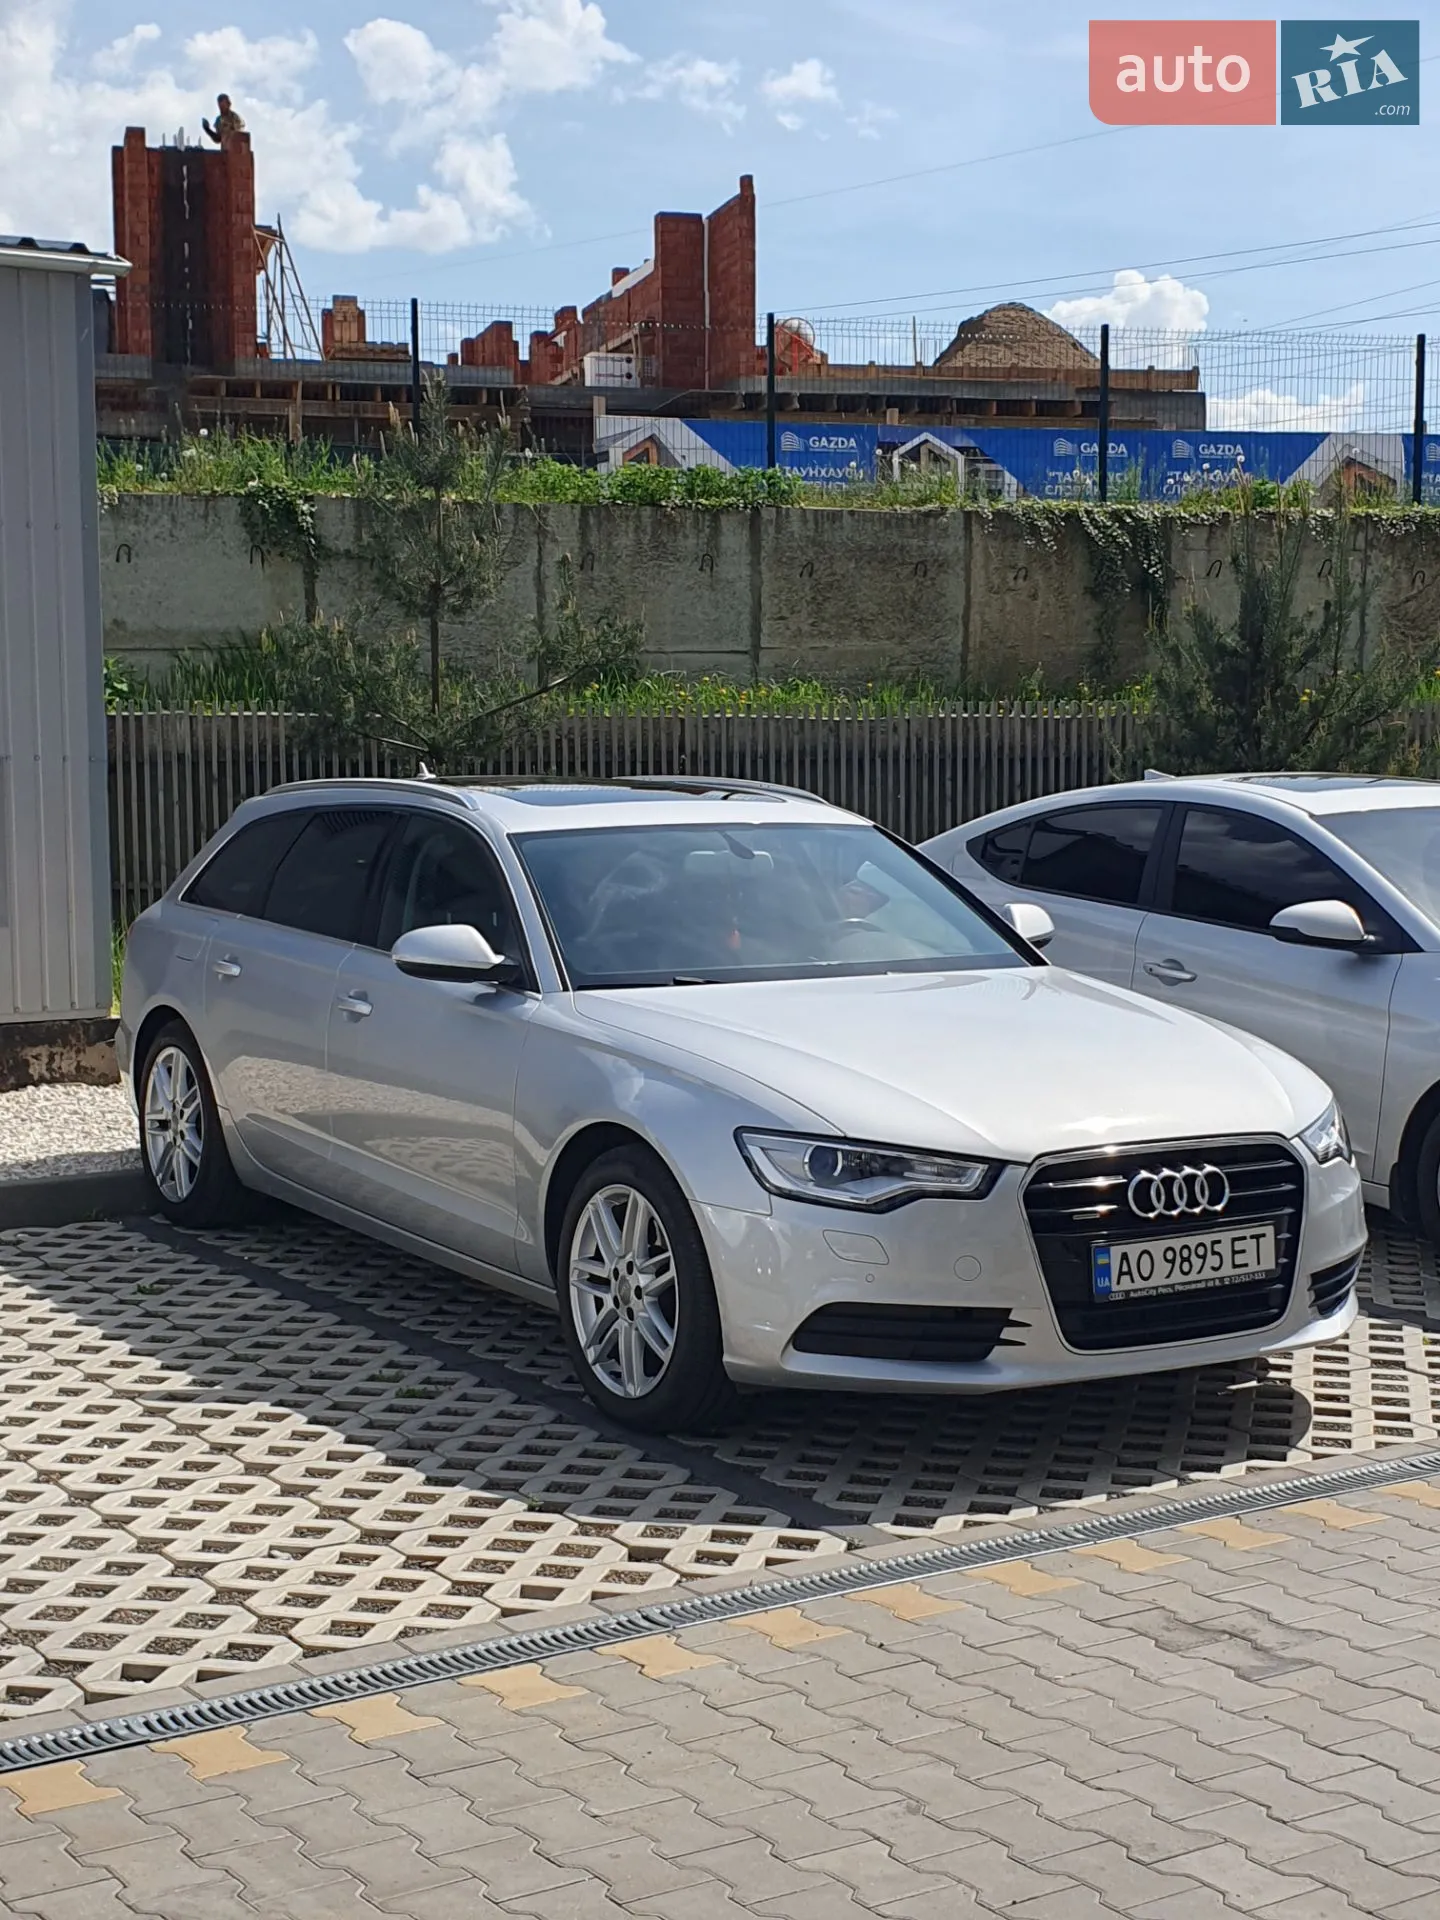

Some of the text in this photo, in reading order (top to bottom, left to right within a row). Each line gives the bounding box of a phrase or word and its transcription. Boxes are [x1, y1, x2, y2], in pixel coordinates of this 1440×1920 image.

[809, 437, 856, 449] GAZDA
[1080, 442, 1127, 454] GADA
[1199, 444, 1243, 455] GAZDA
[1116, 1233, 1266, 1285] AO 9895 ET
[1097, 1277, 1110, 1287] UA
